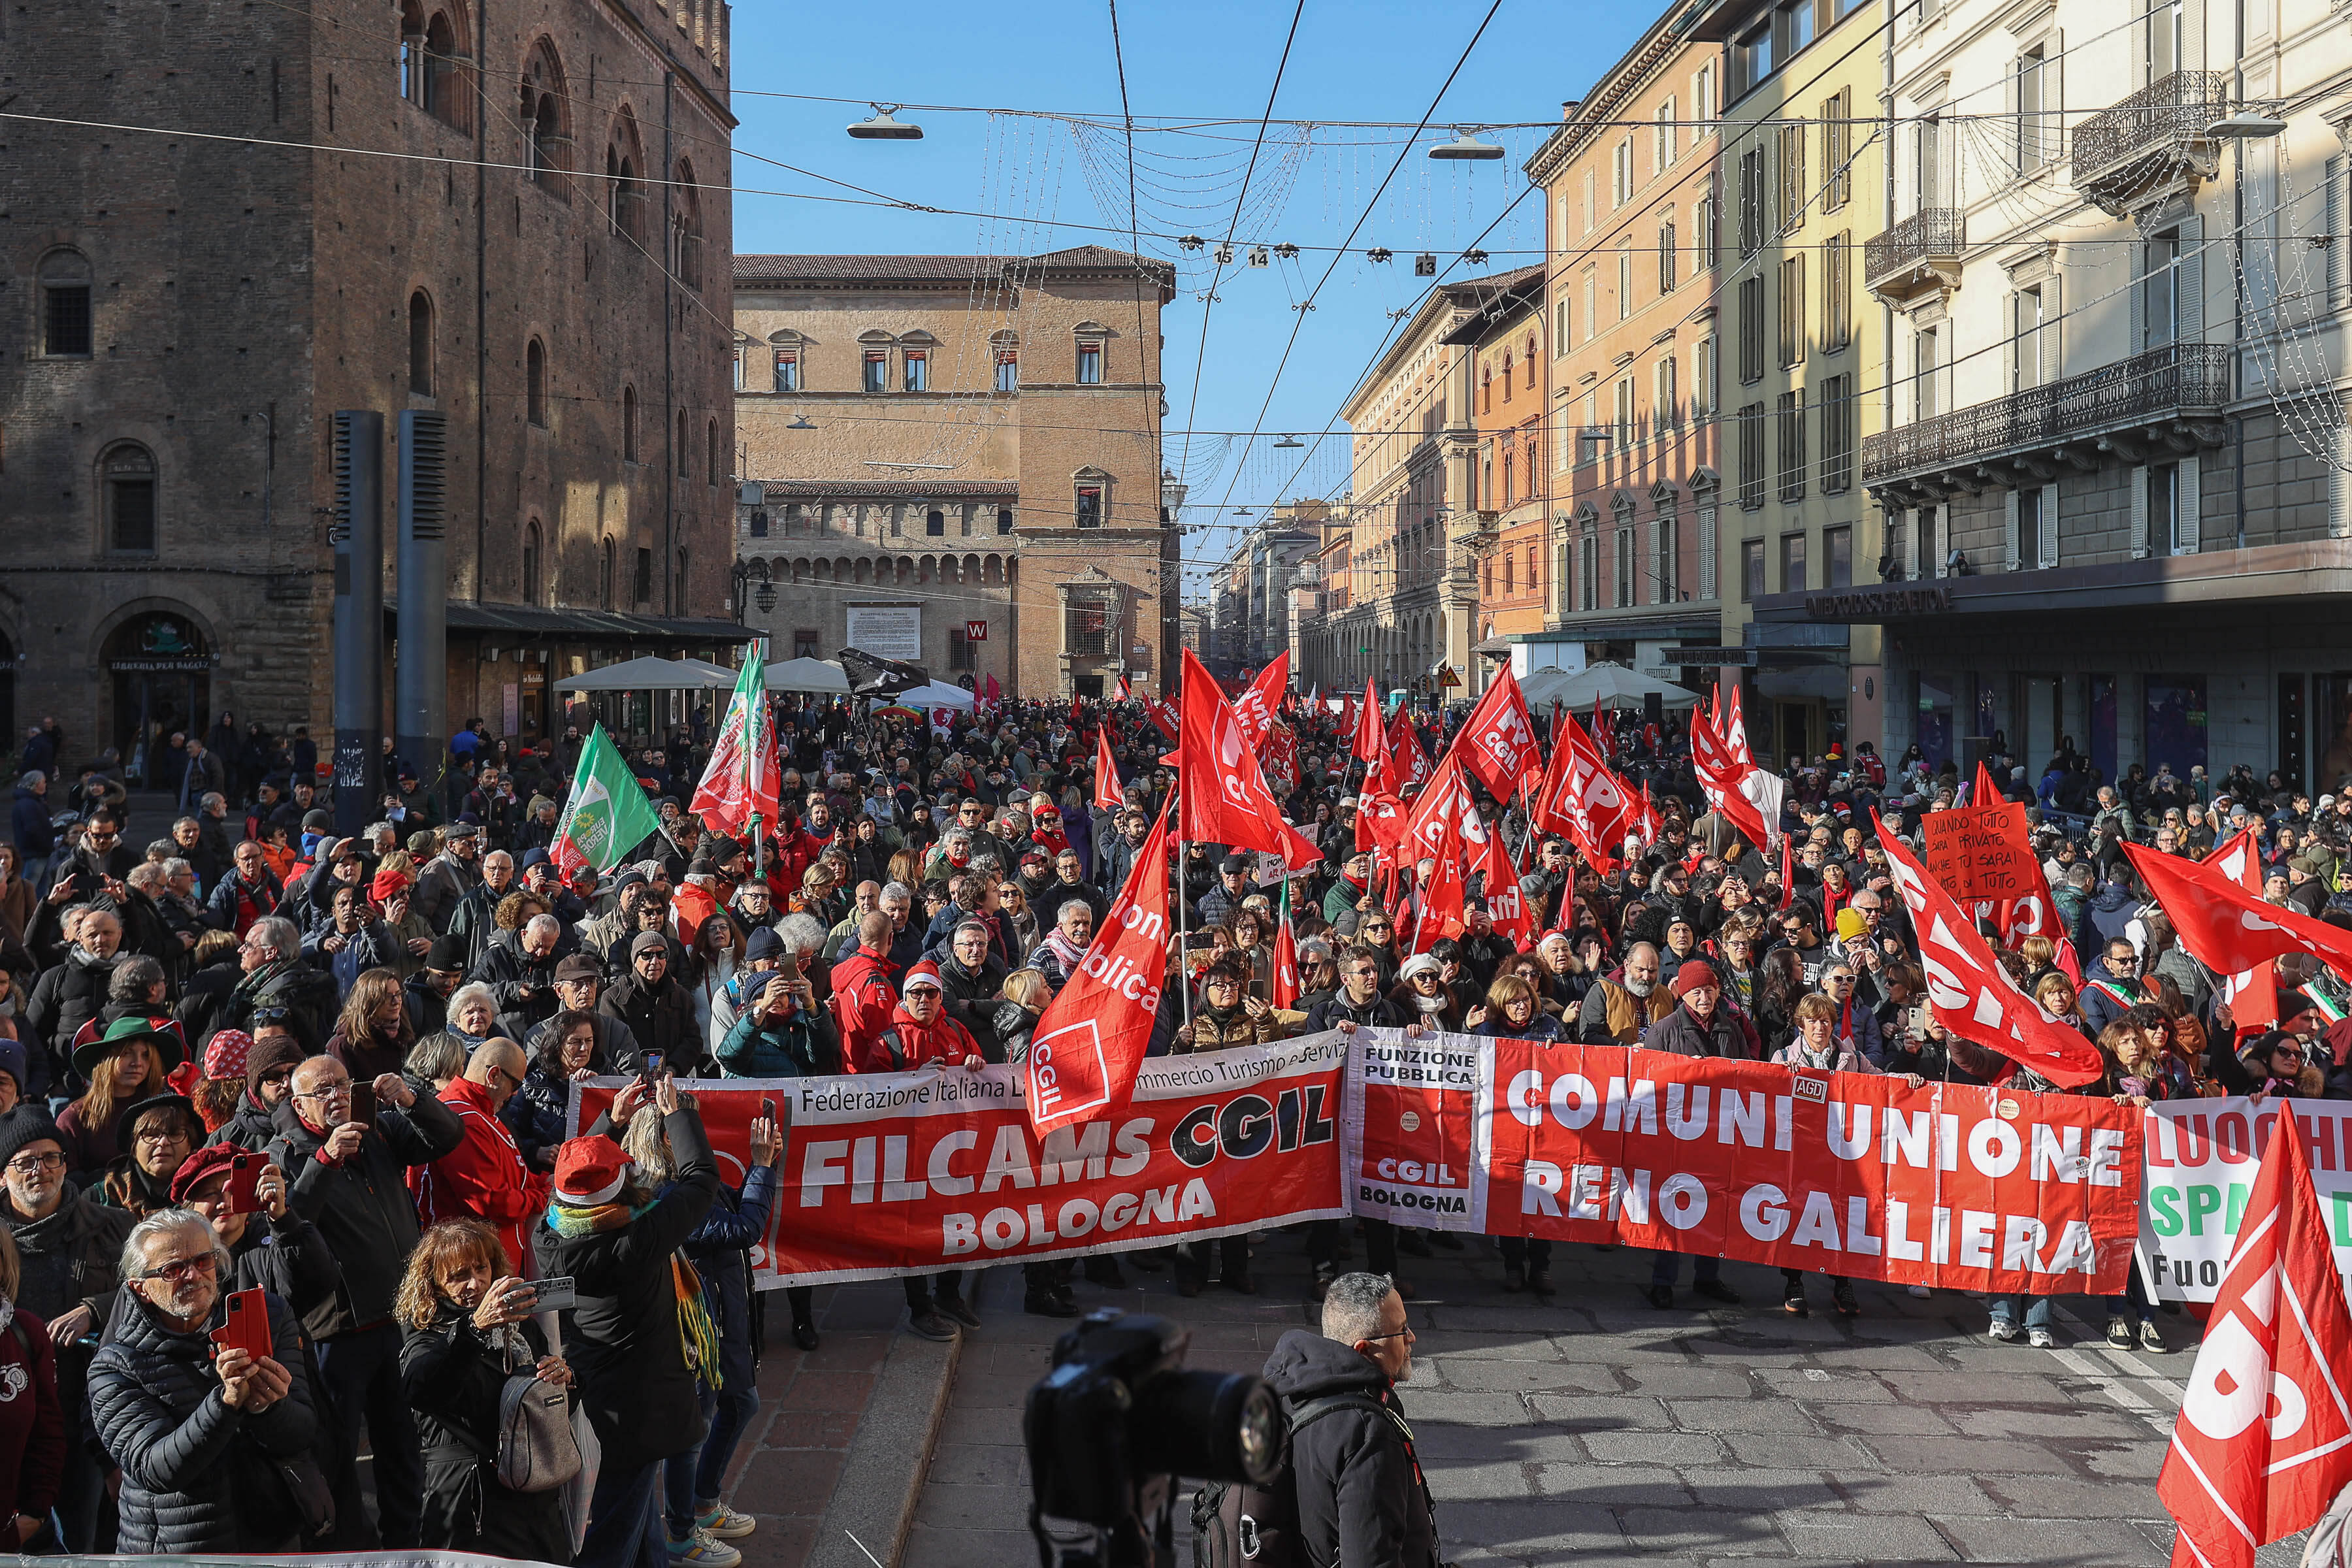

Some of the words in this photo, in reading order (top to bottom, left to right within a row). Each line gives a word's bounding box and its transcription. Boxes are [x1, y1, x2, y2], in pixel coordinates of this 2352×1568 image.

[1214, 252, 1232, 263] 15
[1249, 253, 1269, 266] 14
[1416, 262, 1436, 274] 13
[1891, 587, 1950, 611] BENETTON
[968, 625, 985, 637] W
[1162, 702, 1181, 723] FISAC
[1163, 713, 1179, 732] BOLOG
[1484, 731, 1518, 772] CGIL
[1932, 815, 1969, 836] QUANDO
[1959, 832, 2004, 849] PRIVATO
[1929, 858, 1952, 874] ANCHE
[1957, 855, 1972, 868] TU
[1976, 851, 2017, 866] SARAI
[1938, 875, 1957, 891] VATO
[1082, 941, 1161, 1017] blica
[1365, 1047, 1476, 1069] FUNZIONE
[802, 1086, 930, 1113] Federazione
[936, 1079, 1004, 1103] Italiana
[1214, 1054, 1284, 1085] Turismo
[1288, 1054, 1298, 1066] e
[1035, 1043, 1062, 1116] CGIL
[1364, 1064, 1474, 1085] PUBBLICA
[1797, 1080, 1822, 1096] AGD
[1506, 1069, 1793, 1152] COMUNI
[1828, 1101, 2123, 1189] UNIONE
[800, 1116, 1156, 1207] FILCAMS
[1169, 1084, 1333, 1169] CGIL
[1377, 1158, 1456, 1186] CGIL
[1360, 1185, 1467, 1214] BOLOGNA
[942, 1176, 1217, 1256] BOLOGNA
[1521, 1158, 1710, 1232] RENO
[1739, 1183, 2097, 1275] GALLIERA
